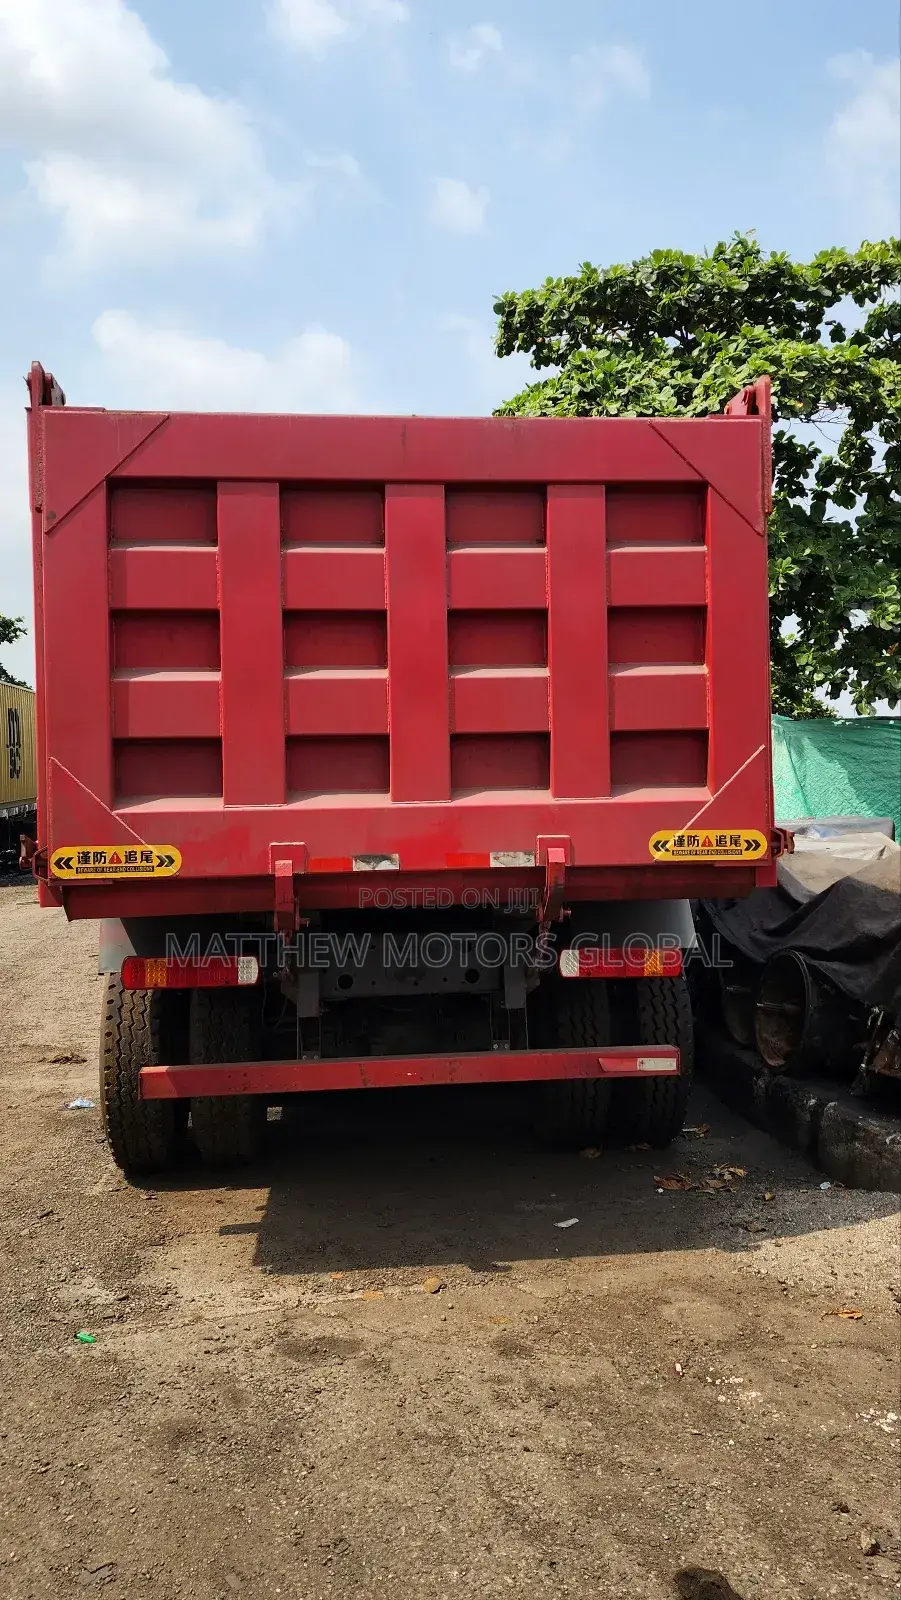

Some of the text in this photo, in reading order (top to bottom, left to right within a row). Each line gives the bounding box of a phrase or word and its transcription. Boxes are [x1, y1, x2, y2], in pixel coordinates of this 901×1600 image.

[673, 834, 742, 848] 谨防 追尾
[77, 850, 154, 865] 谨防 追尾
